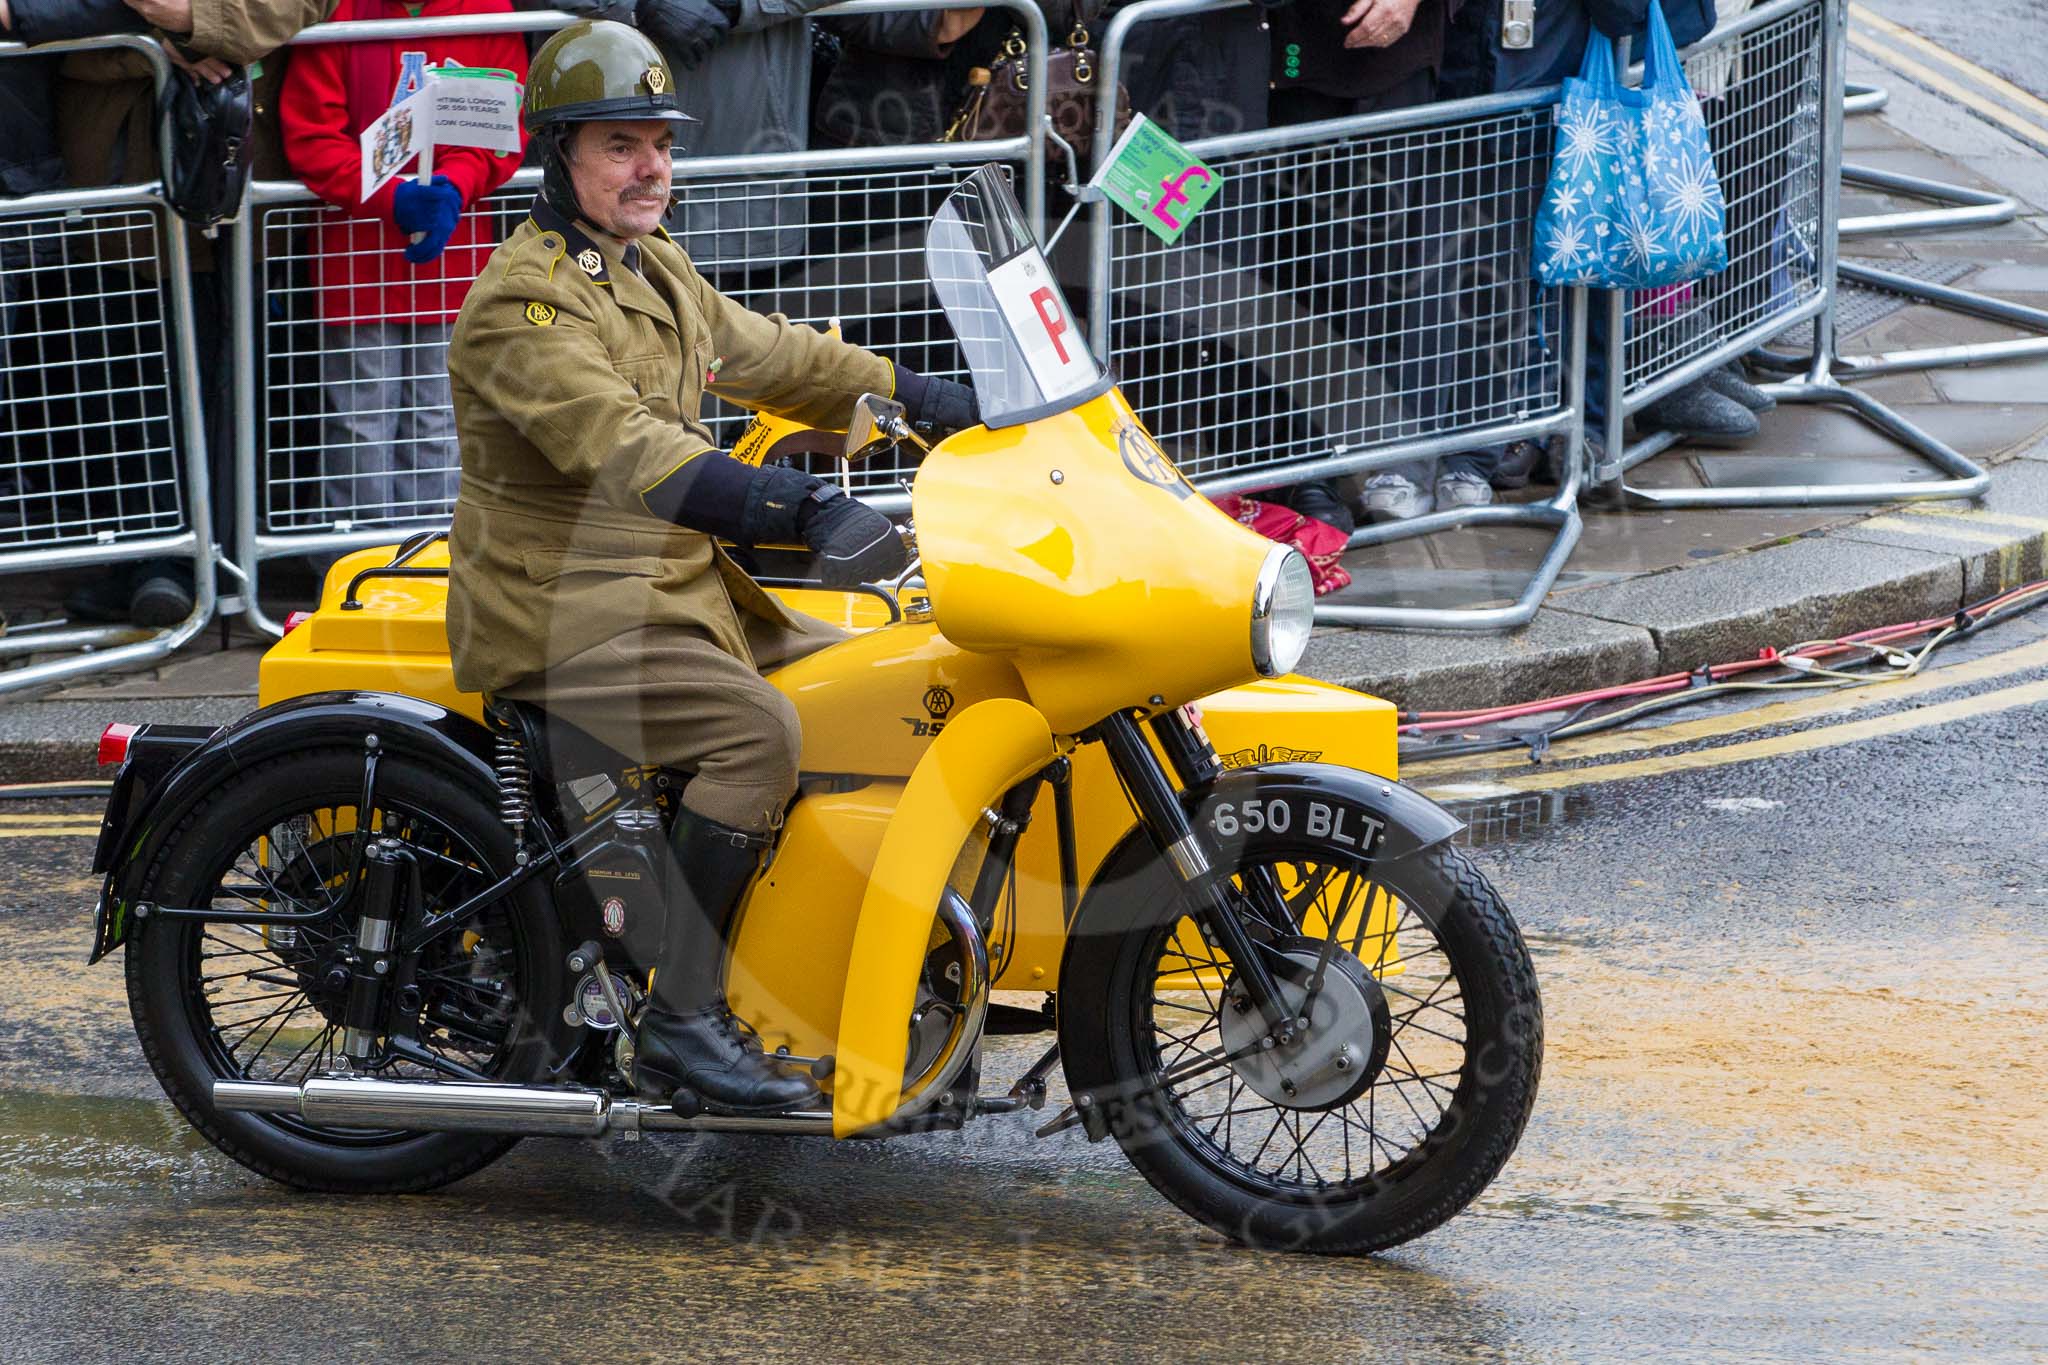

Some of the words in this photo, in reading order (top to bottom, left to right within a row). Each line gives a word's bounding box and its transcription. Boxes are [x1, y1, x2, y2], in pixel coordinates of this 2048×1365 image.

[467, 98, 506, 106] LONDON
[451, 104, 467, 112] 550
[469, 105, 500, 114] YEARS
[459, 120, 515, 131] CHANDLERS
[1029, 286, 1071, 365] P
[1214, 799, 1291, 836] 650
[1307, 802, 1385, 850] BLT
